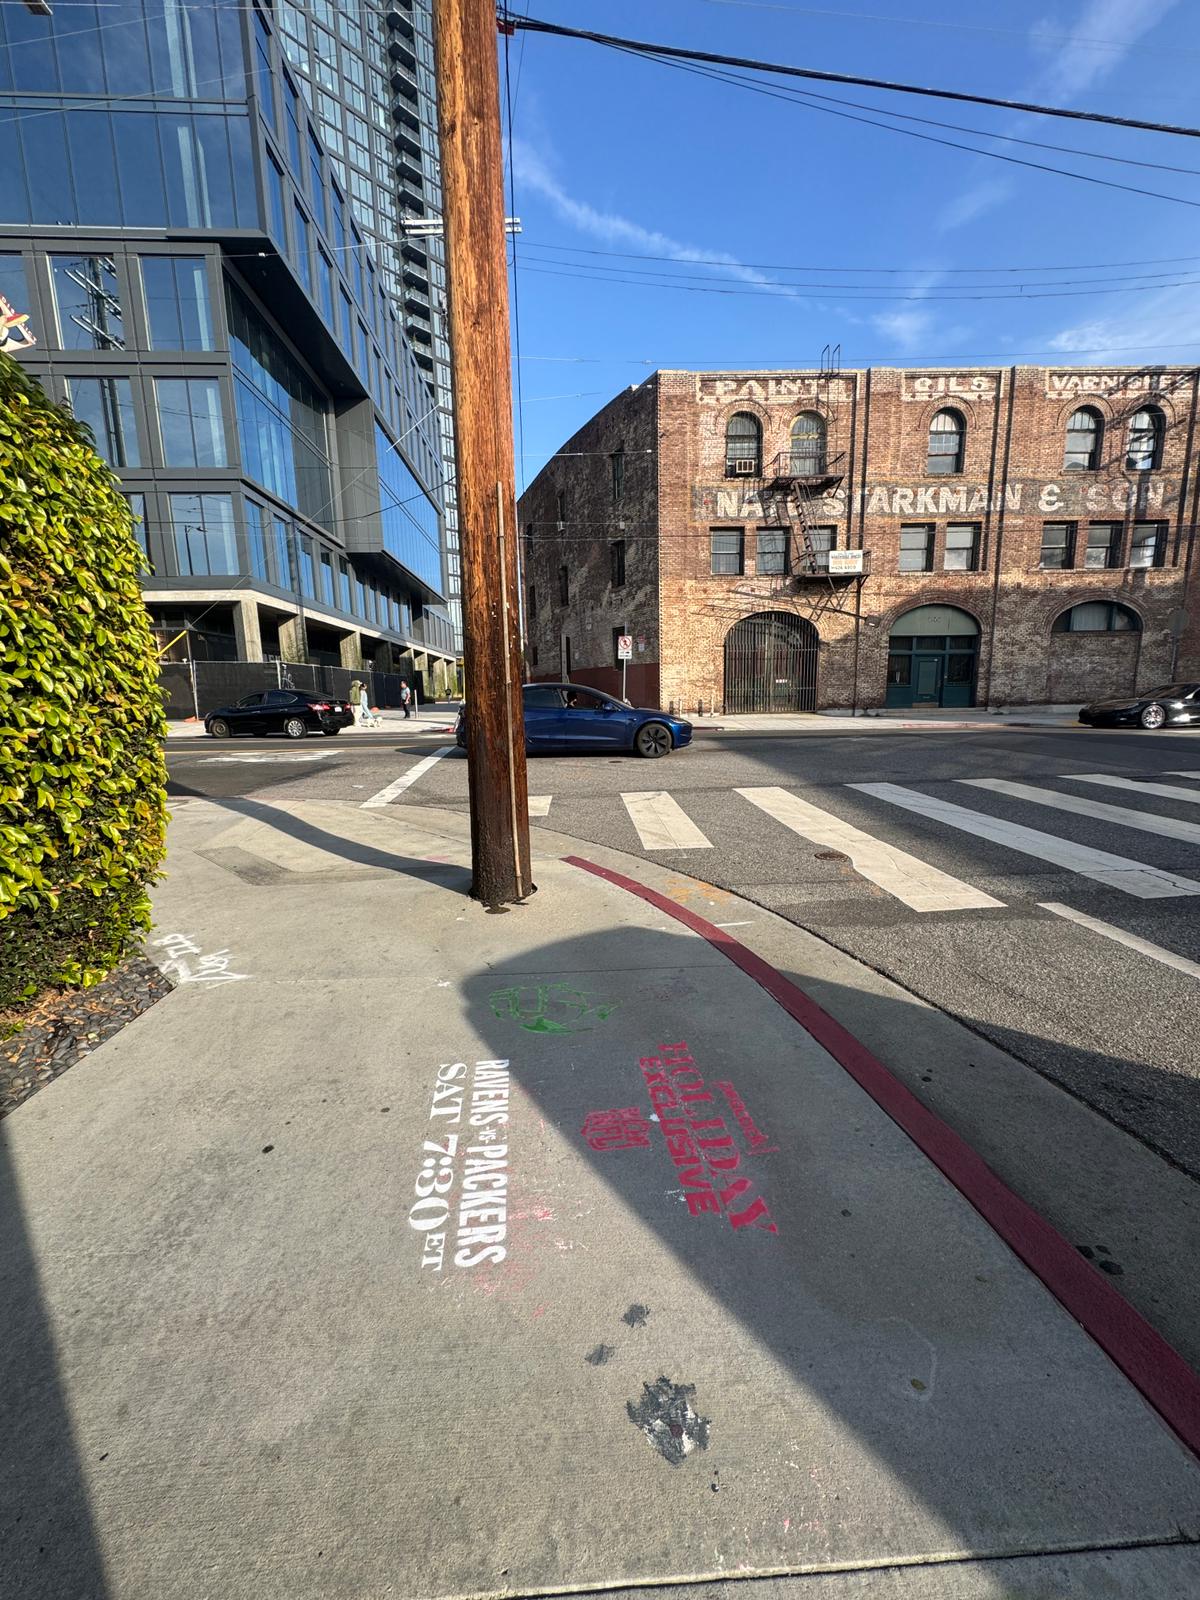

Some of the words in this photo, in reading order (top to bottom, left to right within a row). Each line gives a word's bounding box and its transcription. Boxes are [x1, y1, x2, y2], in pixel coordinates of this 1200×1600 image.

[914, 377, 990, 392] OILS
[822, 484, 1024, 516] STARKMAN
[1038, 484, 1064, 512] &
[1086, 482, 1164, 512] SON
[429, 1062, 467, 1123] SAT
[469, 1059, 509, 1126] RAVENS
[639, 1056, 721, 1217] EXCLUSIVE
[657, 1040, 779, 1235] HOLIDAY
[408, 1134, 459, 1231] 7:30
[454, 1144, 508, 1268] PACKERS
[421, 1232, 446, 1271] ET
